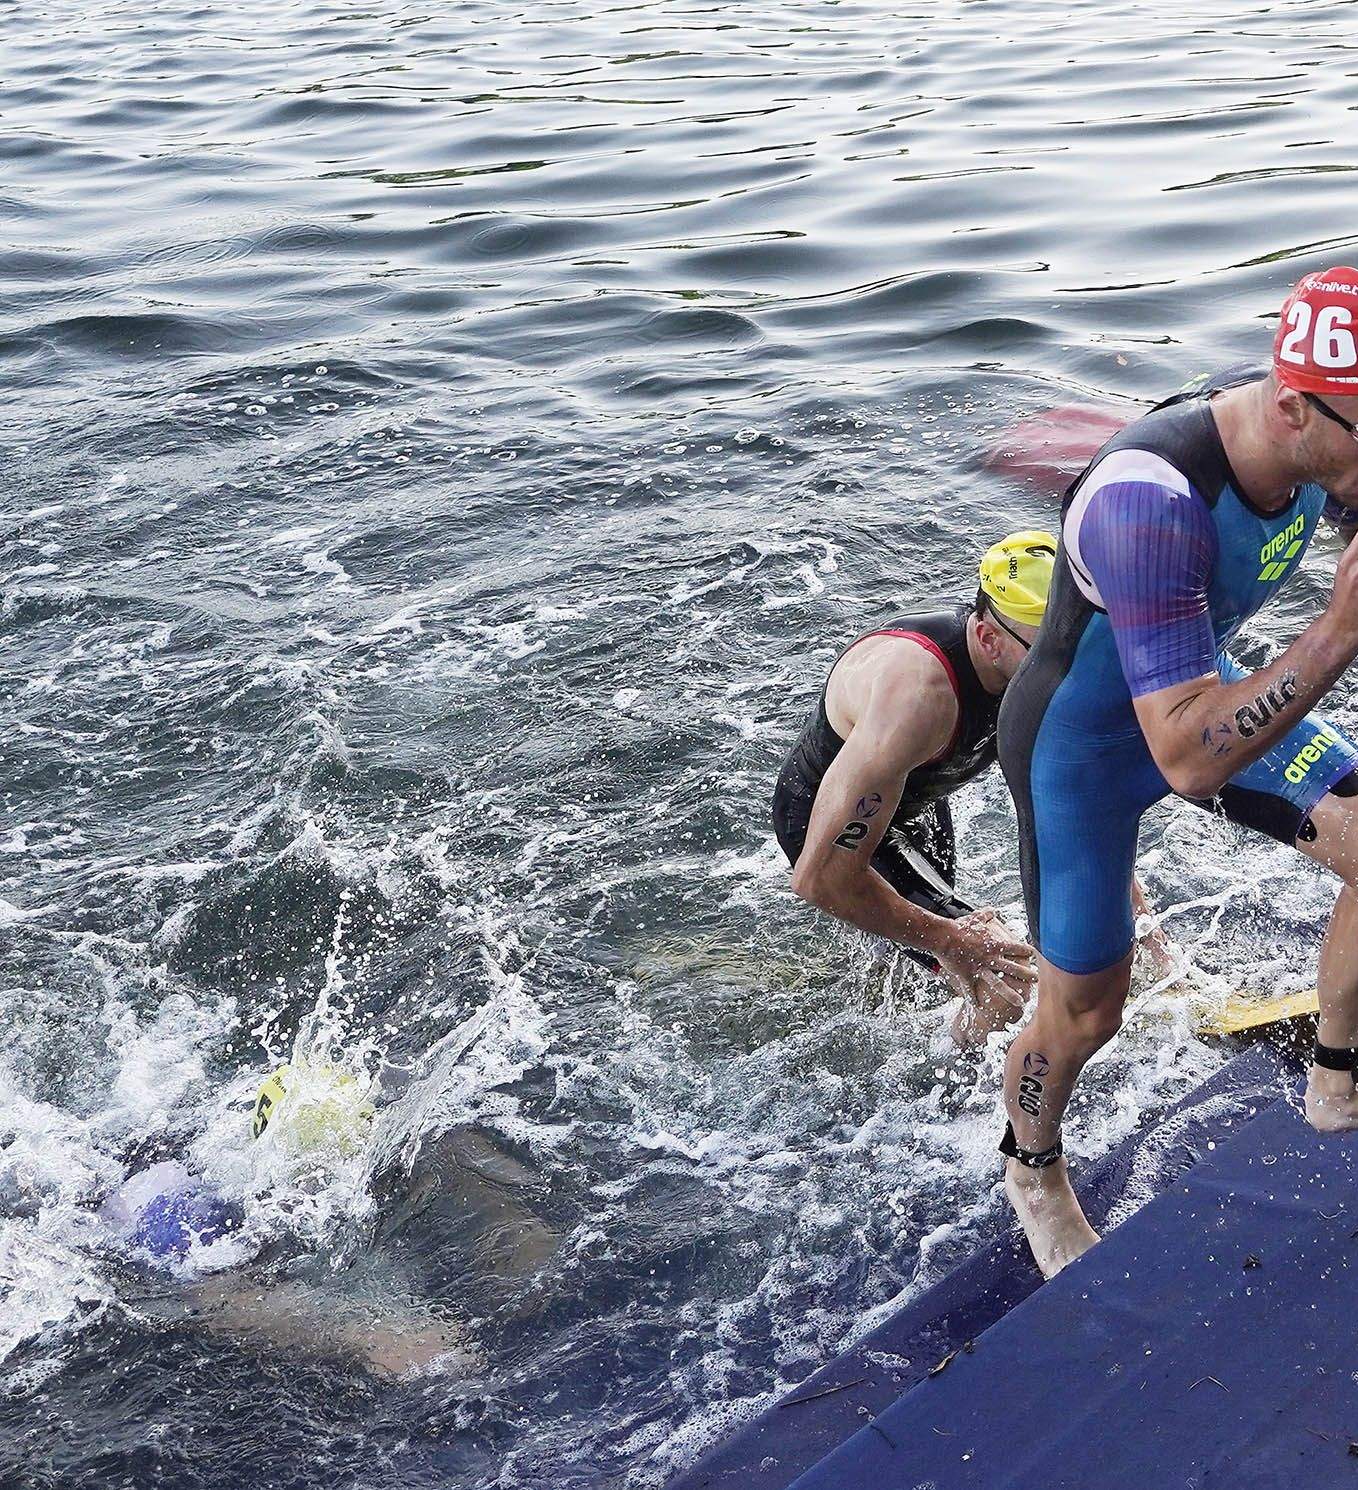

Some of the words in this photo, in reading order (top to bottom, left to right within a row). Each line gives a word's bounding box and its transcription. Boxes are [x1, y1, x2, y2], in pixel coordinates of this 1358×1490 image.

[1280, 301, 1357, 368] 26
[1260, 513, 1305, 564] arena
[832, 820, 870, 852] 2
